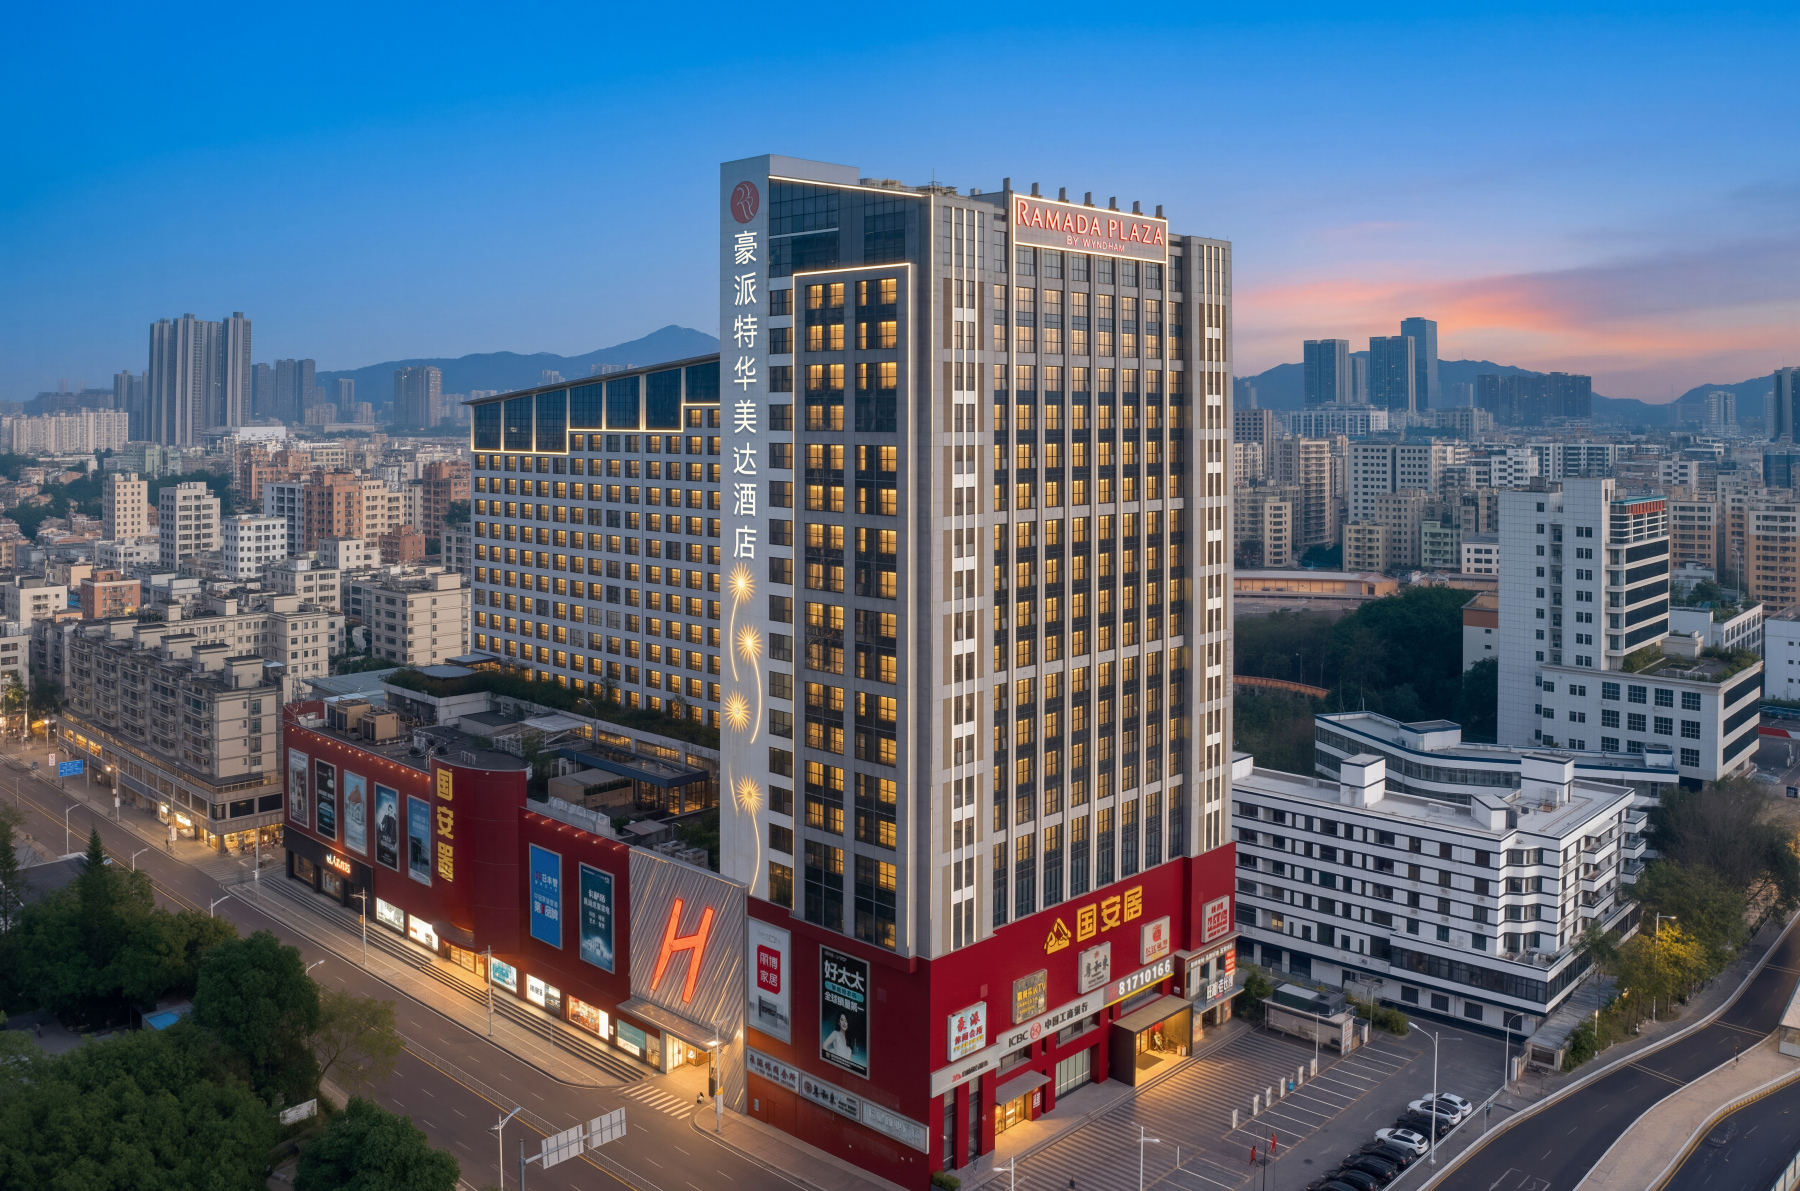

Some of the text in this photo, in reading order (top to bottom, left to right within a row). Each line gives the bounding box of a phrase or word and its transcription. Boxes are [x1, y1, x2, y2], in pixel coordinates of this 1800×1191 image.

[1016, 199, 1164, 246] RAMADA PLAZA
[1066, 234, 1126, 253] BY WYNDHAM
[733, 230, 758, 560] 豪派特华美达酒店
[1076, 884, 1143, 943] 国安居
[650, 897, 715, 1004] H
[760, 969, 778, 987] 家居
[823, 959, 865, 992] 好太太
[1118, 958, 1171, 996] 81710166
[1044, 1001, 1089, 1030] 中国工商银行
[1008, 1029, 1029, 1048] ICBC
